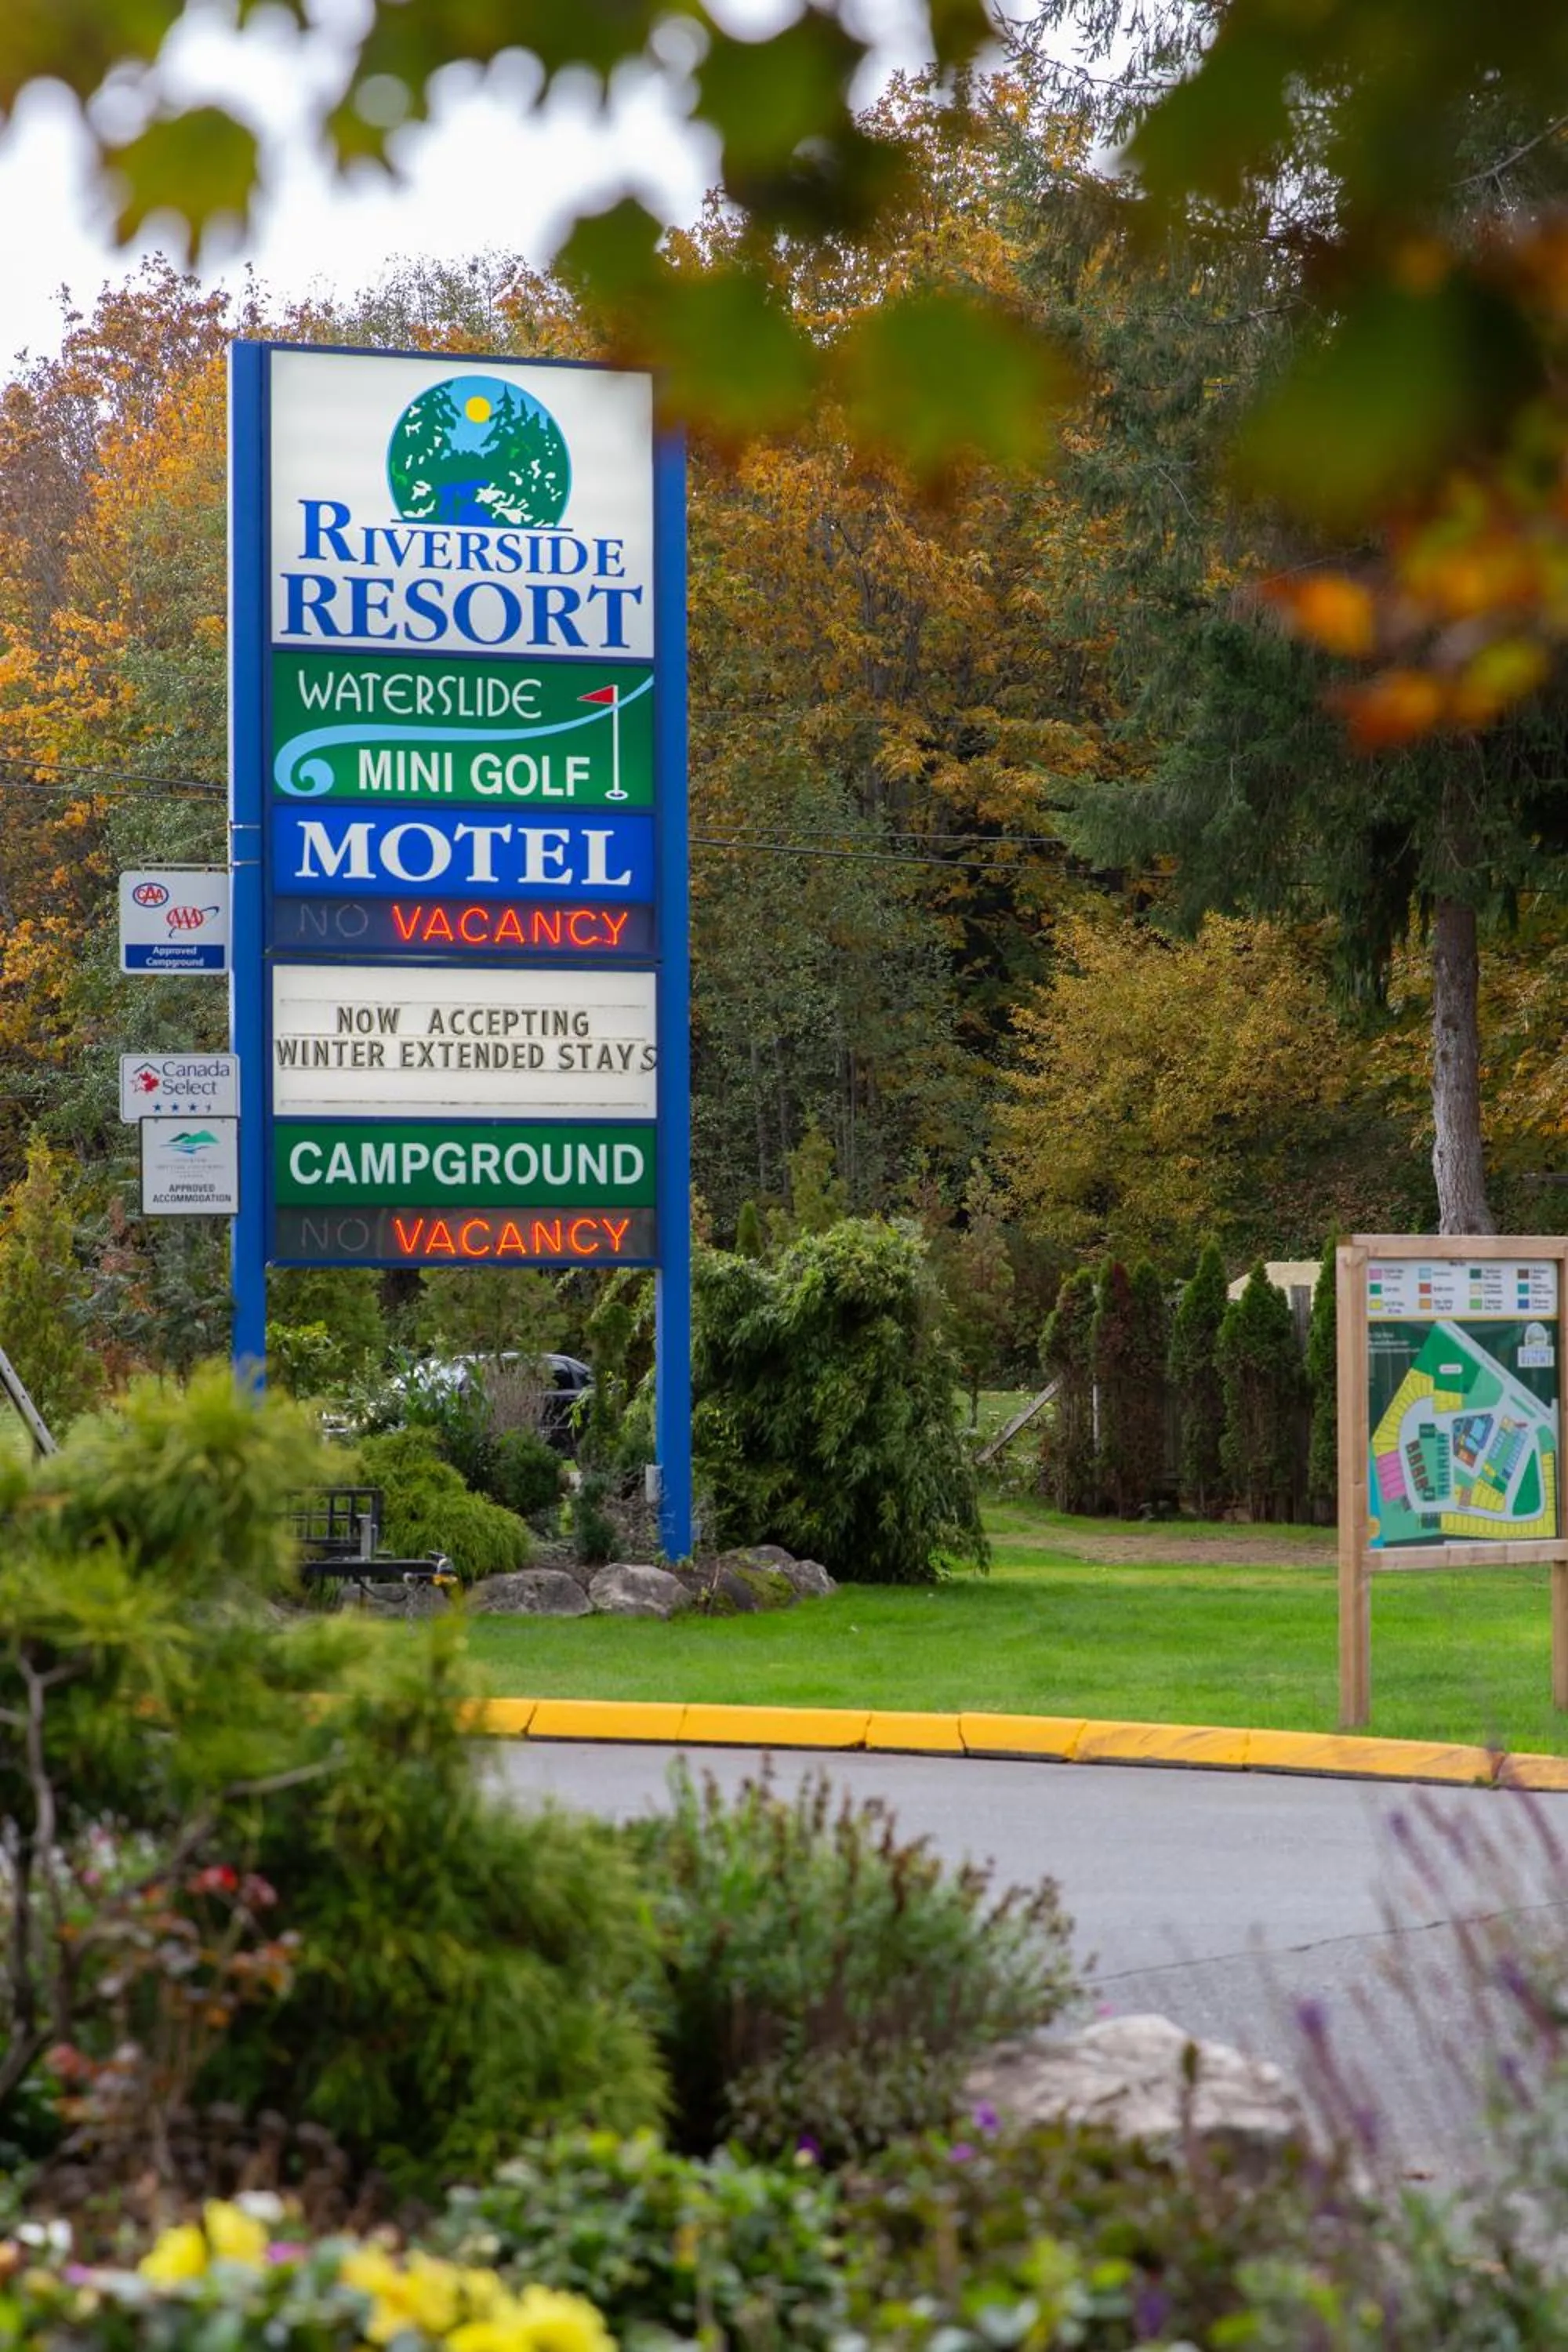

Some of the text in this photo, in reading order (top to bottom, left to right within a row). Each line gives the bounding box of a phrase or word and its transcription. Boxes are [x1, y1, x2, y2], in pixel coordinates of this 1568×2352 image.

[280, 572, 643, 648] RESORT
[297, 670, 543, 719] WATERSLIDE
[358, 749, 590, 797] MINI GOLF
[294, 820, 631, 886] MOTEL
[136, 885, 164, 903] CAA
[168, 907, 203, 929] AAA
[296, 902, 628, 946] NO VACANCY
[145, 956, 205, 967] Campground
[152, 946, 198, 956] Approved
[336, 1006, 590, 1036] NOW ACCEPTING
[162, 1060, 230, 1078] Canada
[276, 1039, 658, 1073] WINTER EXTENDED STAYS
[162, 1079, 217, 1096] Select
[289, 1141, 644, 1185] CAMPGROUND
[152, 1194, 232, 1203] ACCOMMODATION
[169, 1184, 216, 1192] APPROVED
[300, 1218, 630, 1255] NO VACANCY
